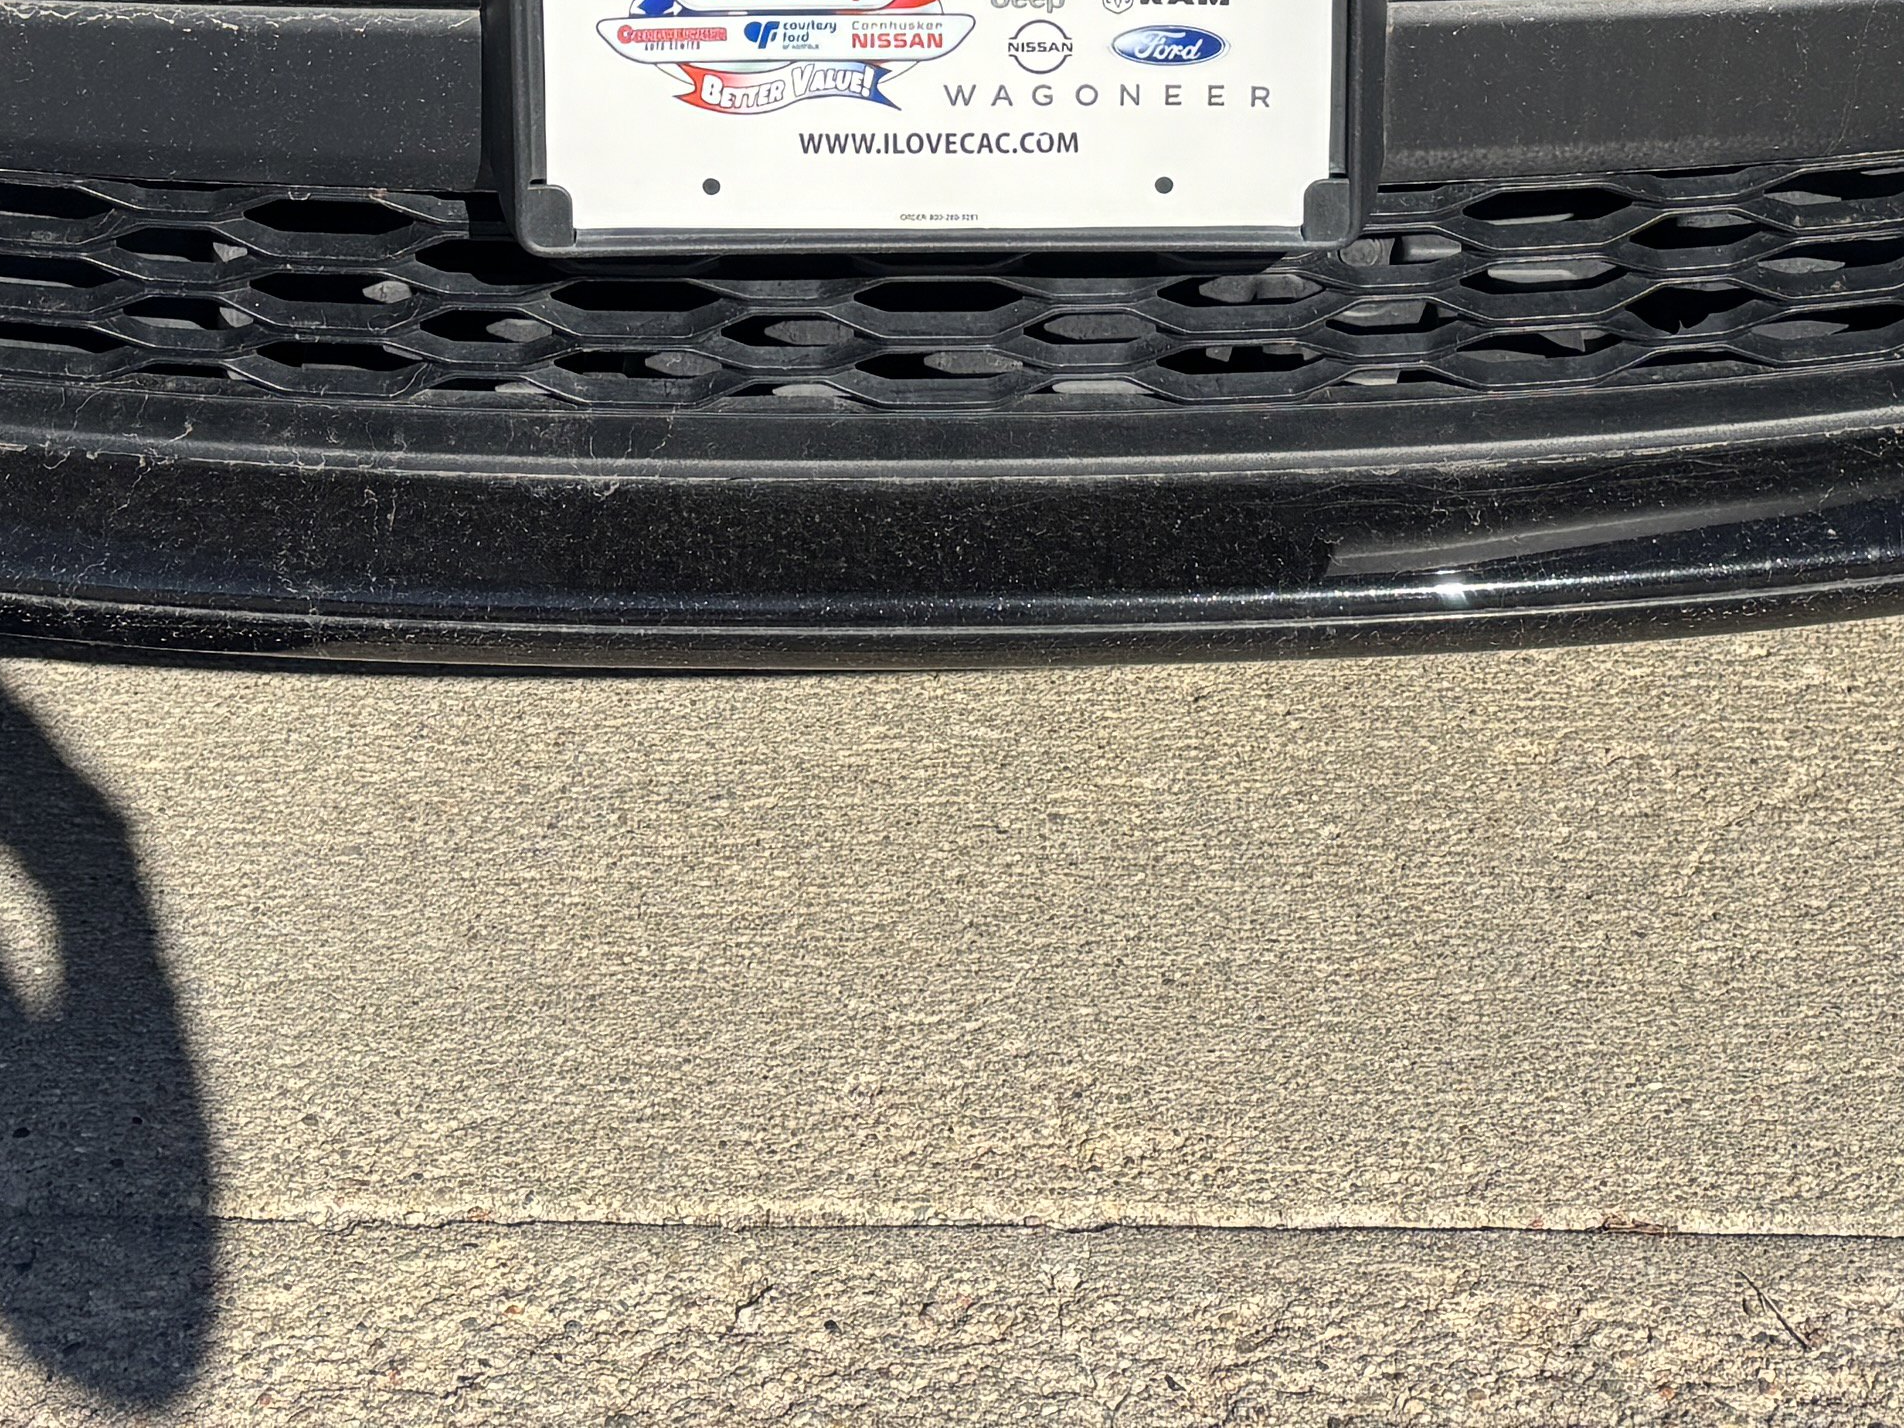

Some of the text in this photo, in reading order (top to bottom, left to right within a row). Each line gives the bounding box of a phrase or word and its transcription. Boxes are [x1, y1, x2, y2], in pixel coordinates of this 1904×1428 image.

[852, 20, 943, 30] Cornhusker
[852, 33, 943, 48] NISSAN
[1008, 42, 1074, 53] NISSAN
[1134, 30, 1203, 60] Ford
[701, 74, 786, 109] BETTER
[943, 84, 1271, 108] WAGONEER
[798, 132, 1080, 154] WWW.ILOVECAC.COM
